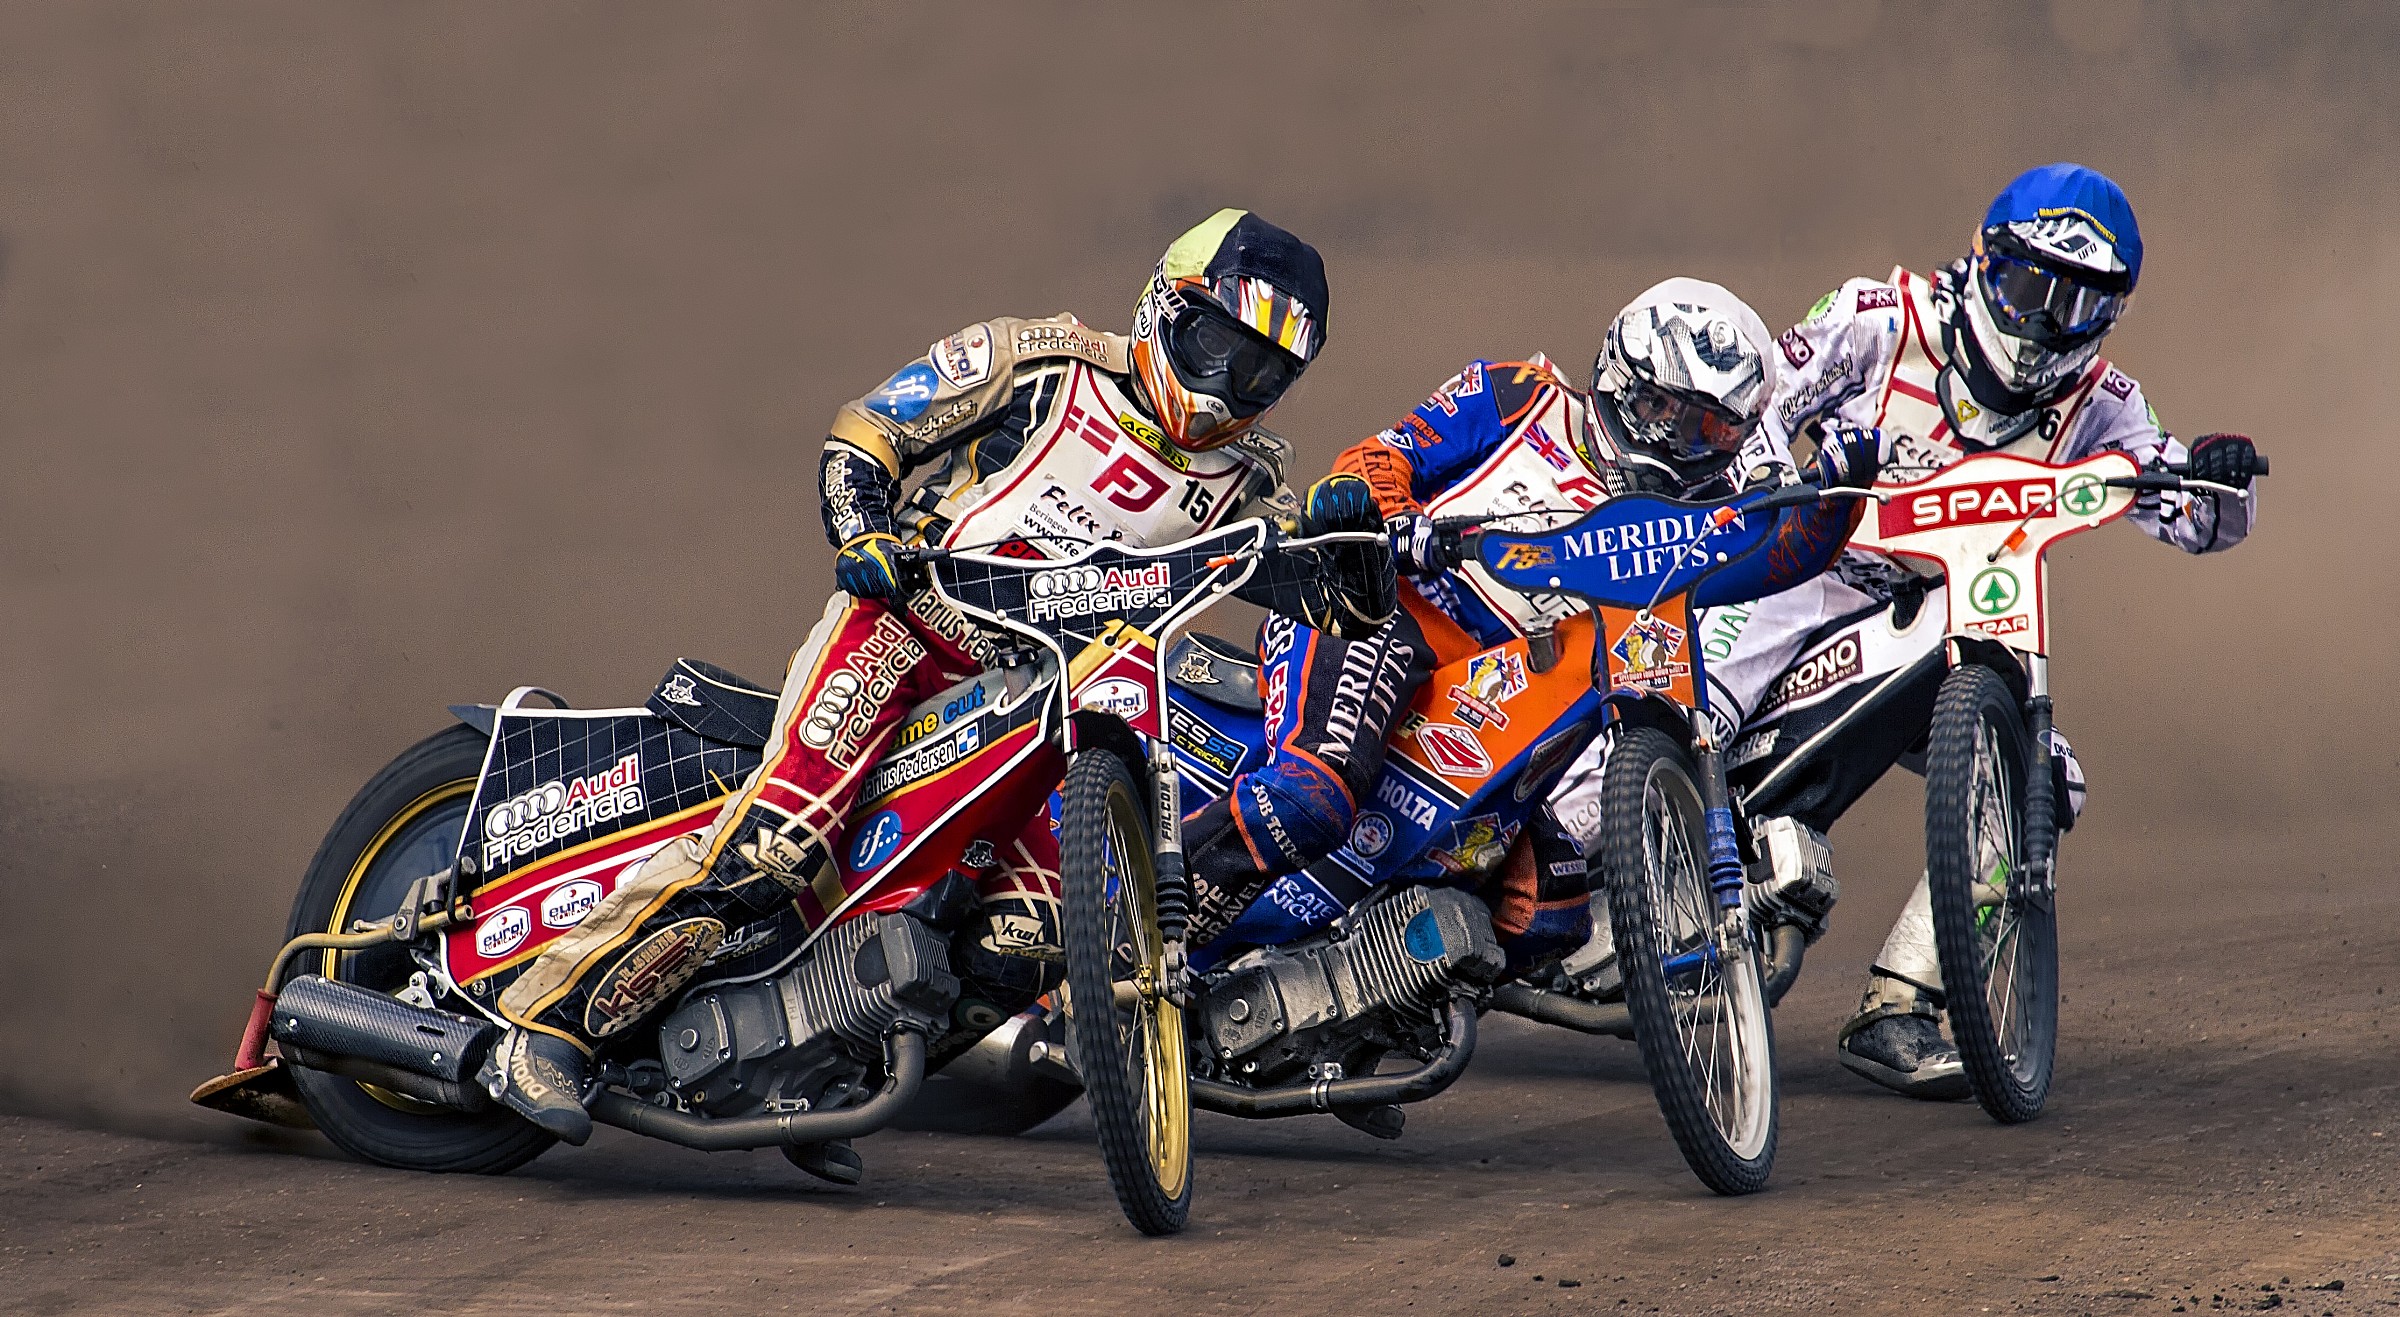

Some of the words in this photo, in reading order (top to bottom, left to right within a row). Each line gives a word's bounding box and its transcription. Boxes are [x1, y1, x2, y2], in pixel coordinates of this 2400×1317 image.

[2078, 242, 2097, 260] UFO
[1017, 338, 1110, 364] Fredericia
[1068, 330, 1107, 355] Audi
[1121, 419, 1190, 472] ACERBIS
[1029, 503, 1068, 535] Beringen
[1040, 485, 1101, 534] Felix
[1178, 479, 1215, 525] 15
[1912, 484, 2053, 526] SPAR
[1104, 564, 1168, 590] Audi
[1607, 546, 1709, 581] LIFTS
[1031, 589, 1171, 623] Fredericia
[848, 614, 909, 680] Audi
[827, 636, 926, 769] Fredericia
[943, 682, 986, 723] cut
[1364, 639, 1414, 742] LIFTS
[567, 757, 638, 809] Audi
[895, 740, 958, 785] Pedersen
[1160, 781, 1172, 841] FALCON
[1376, 776, 1439, 832] HOLTA
[485, 787, 644, 872] Fredericia
[549, 892, 596, 920] eurol
[1264, 887, 1318, 926] NICK
[484, 916, 524, 947] eurol
[1001, 921, 1036, 941] kw
